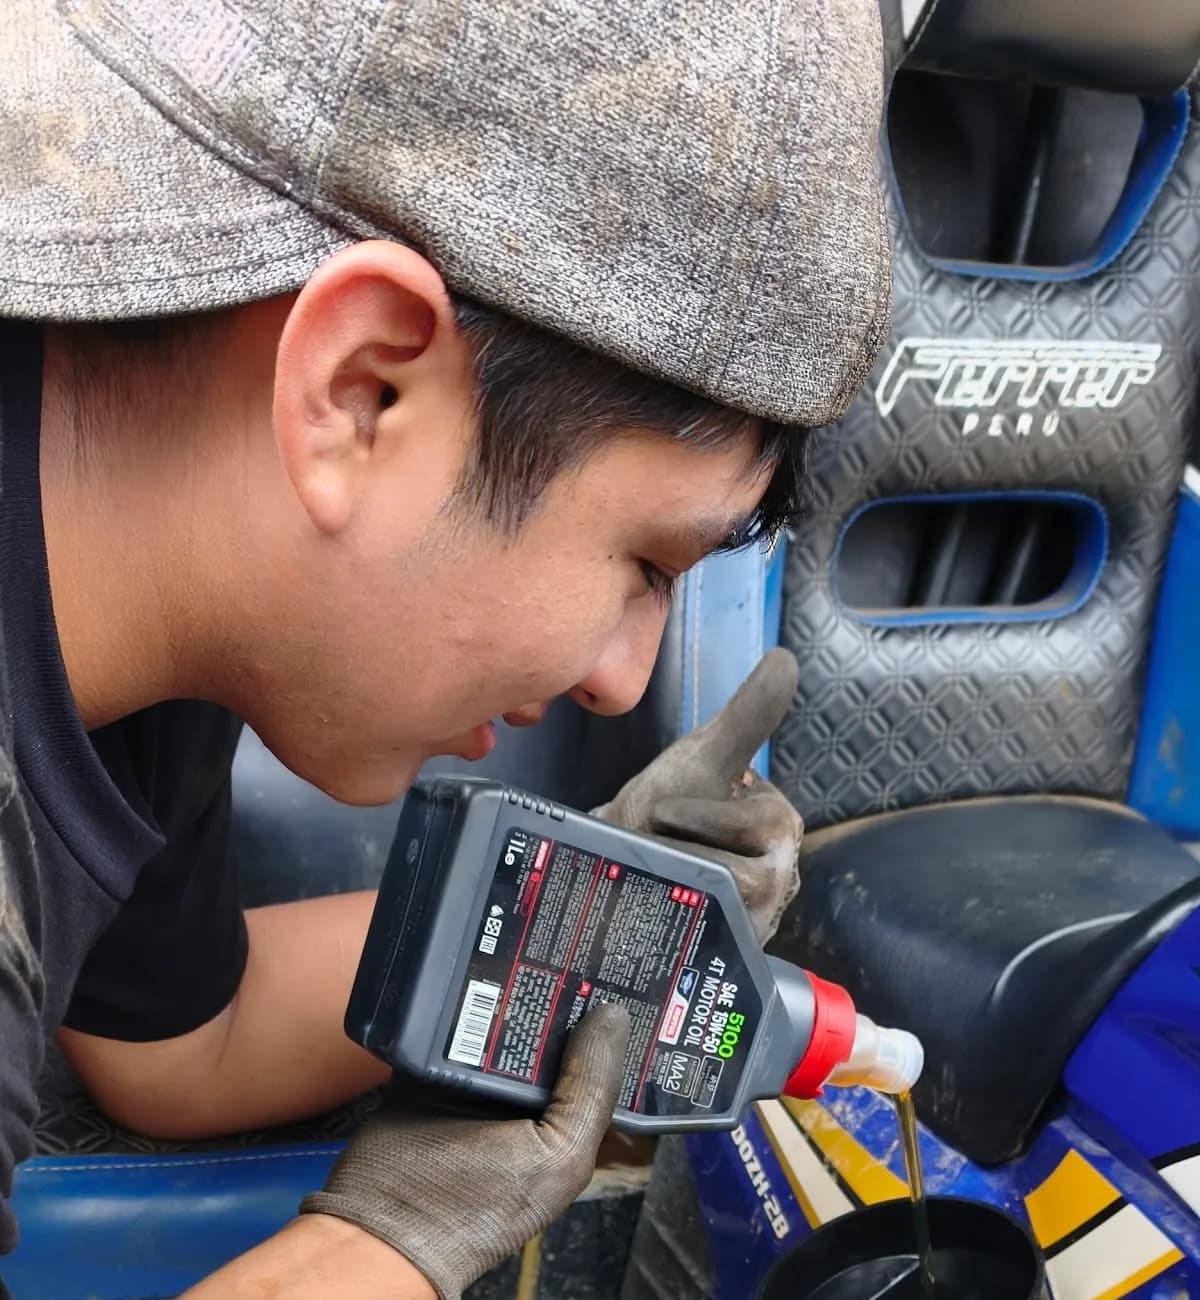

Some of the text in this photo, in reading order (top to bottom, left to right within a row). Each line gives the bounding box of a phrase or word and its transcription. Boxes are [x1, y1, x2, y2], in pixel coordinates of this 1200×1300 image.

[710, 956, 727, 977] 4T
[693, 976, 721, 1028] MOTOR
[717, 981, 738, 1008] SAE
[683, 1023, 704, 1048] OIL
[702, 1010, 729, 1054] 15W-50
[717, 1010, 746, 1059] 5100
[667, 1054, 689, 1091] MA2
